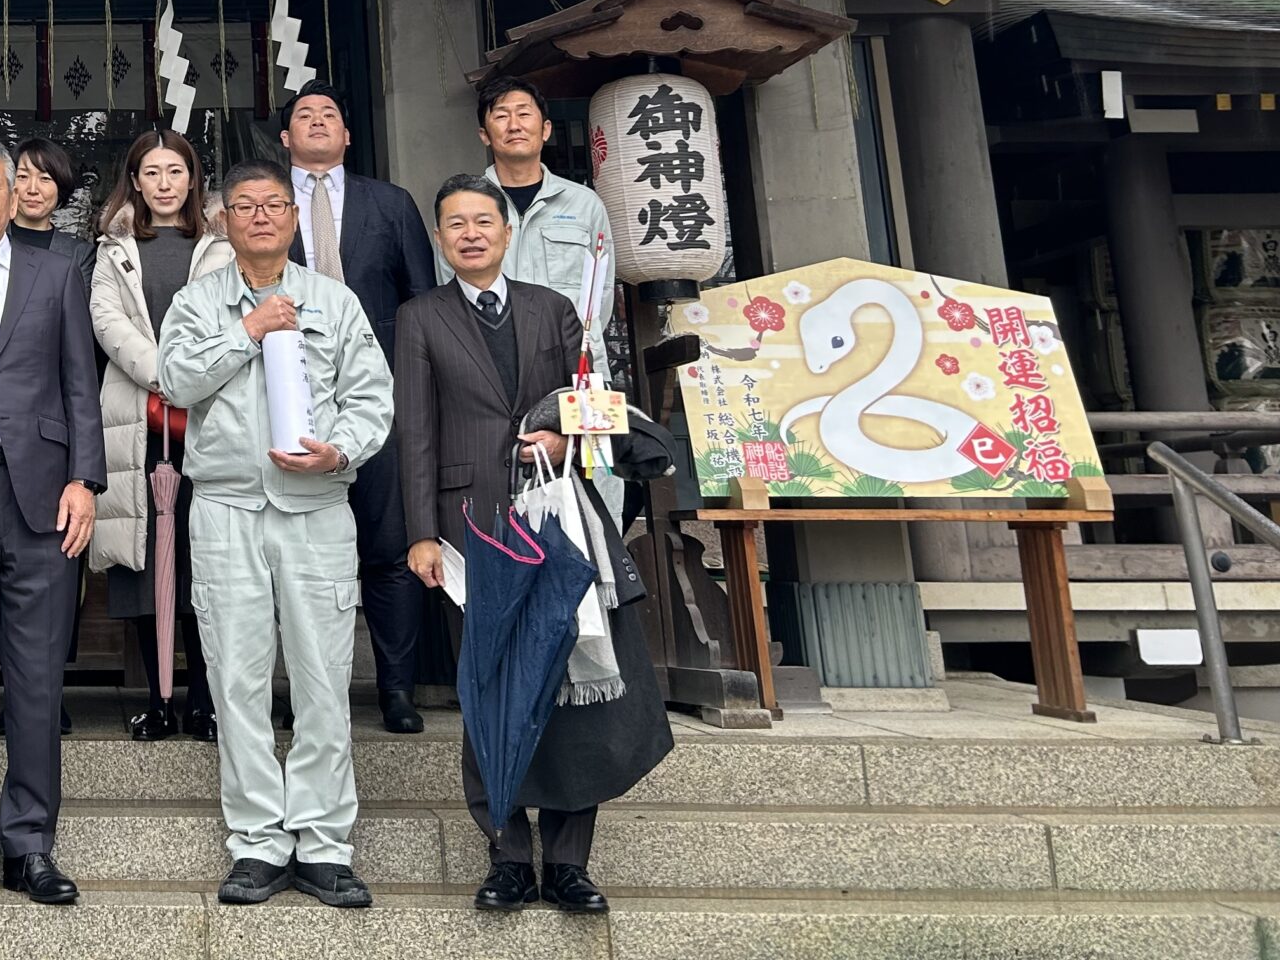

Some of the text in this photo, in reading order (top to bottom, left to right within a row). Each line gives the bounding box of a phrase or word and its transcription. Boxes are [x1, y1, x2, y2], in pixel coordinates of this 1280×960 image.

[626, 84, 715, 251] 御神燈
[740, 374, 768, 439] 令和七年
[984, 306, 1072, 483] 開運招福
